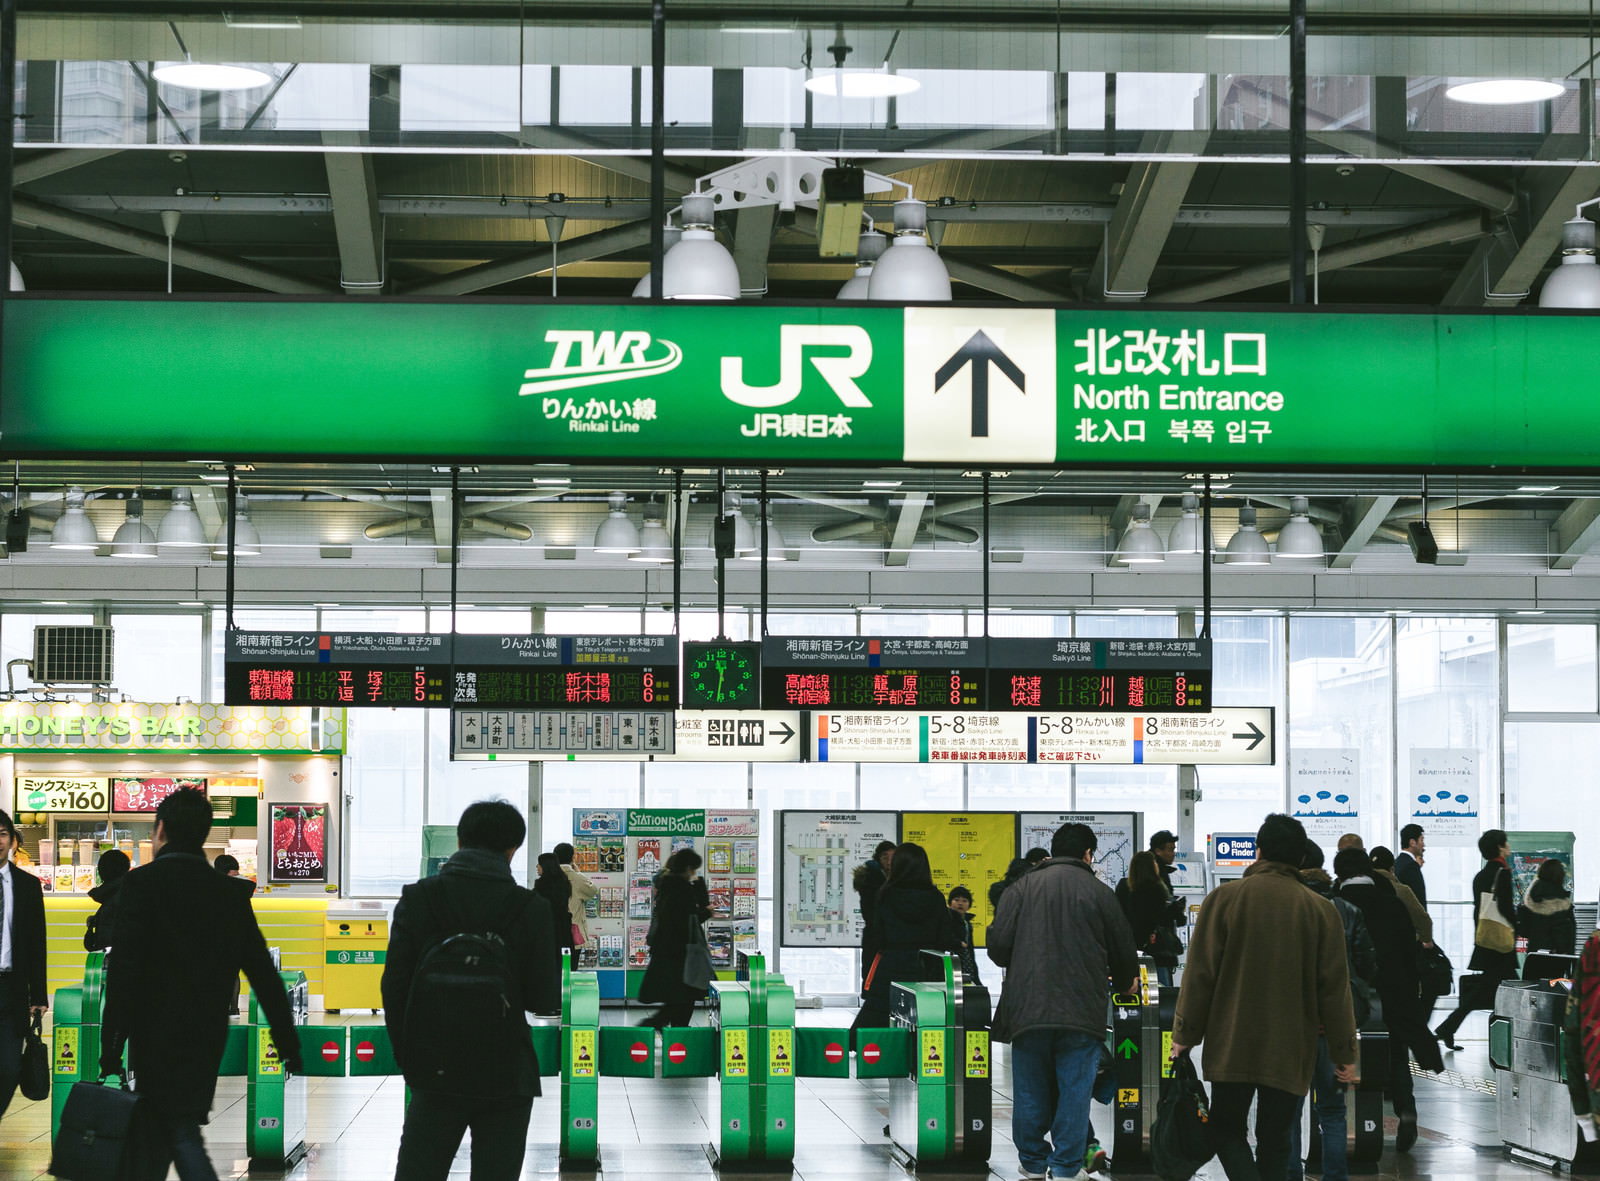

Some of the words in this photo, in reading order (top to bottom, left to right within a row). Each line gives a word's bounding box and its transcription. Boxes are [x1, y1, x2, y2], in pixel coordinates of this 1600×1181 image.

[545, 330, 651, 369] TWR
[1074, 328, 1267, 376] 北改札口
[720, 324, 873, 408] JR
[1074, 384, 1149, 410] North
[1159, 384, 1284, 411] Entrance
[542, 398, 657, 420] りんかい線
[569, 420, 608, 432] Rinkai
[612, 420, 640, 433] Line
[740, 413, 852, 438] JR東日本
[1074, 418, 1145, 442] 北入口
[1168, 419, 1215, 443] 북쪽
[1225, 420, 1272, 443] 입구
[235, 635, 315, 647] 湘南新宿ライン
[334, 636, 441, 646] 横浜・大船・小田原・逗子方面
[501, 638, 557, 649] りんかい線
[576, 638, 664, 647] 東京テレポート・新木場方面
[786, 640, 865, 651] 湘南新宿ライン
[884, 640, 968, 649] 大宮・宇都宮・高崎方面
[1057, 641, 1091, 653] 埼京線
[1109, 642, 1196, 651] 新宿・池袋・赤羽・大宮方面
[697, 661, 707, 669] 10
[1077, 654, 1091, 662] Line
[415, 672, 425, 686] 5
[455, 672, 477, 682] 先発
[566, 672, 610, 687] 新木場
[643, 673, 654, 688] 6
[785, 674, 829, 689] 高崎線
[950, 675, 960, 690] 8
[1011, 675, 1041, 691] 快速
[1175, 677, 1186, 692] 8
[415, 686, 425, 701] 5
[455, 688, 476, 698] 次発
[566, 687, 610, 703] 新木場
[643, 688, 654, 703] 6
[873, 689, 918, 705] 宇都宮
[950, 690, 960, 705] 8
[1011, 691, 1041, 706] 快速
[1175, 692, 1186, 706] 8
[0, 716, 130, 736] HONEY'S
[141, 716, 201, 736] BAR
[831, 715, 842, 733] 5
[844, 715, 909, 726] 湘南新宿ライン
[968, 716, 999, 726] 埼京線
[1075, 717, 1126, 727] りんかい線
[1146, 717, 1158, 735] 8
[1160, 717, 1225, 728] 湘南新宿ライン
[466, 717, 476, 744] 大崎
[492, 715, 502, 746] 大井町
[623, 718, 633, 745] 東雲
[649, 716, 659, 747] 新木場
[931, 751, 1027, 760] 発車番線は発車時刻表
[1039, 752, 1101, 761] をご確認下さい
[24, 780, 97, 791] ミックスジュース
[1231, 841, 1252, 849] Route
[1231, 849, 1254, 857] Finder
[277, 858, 321, 869] とちおとめ
